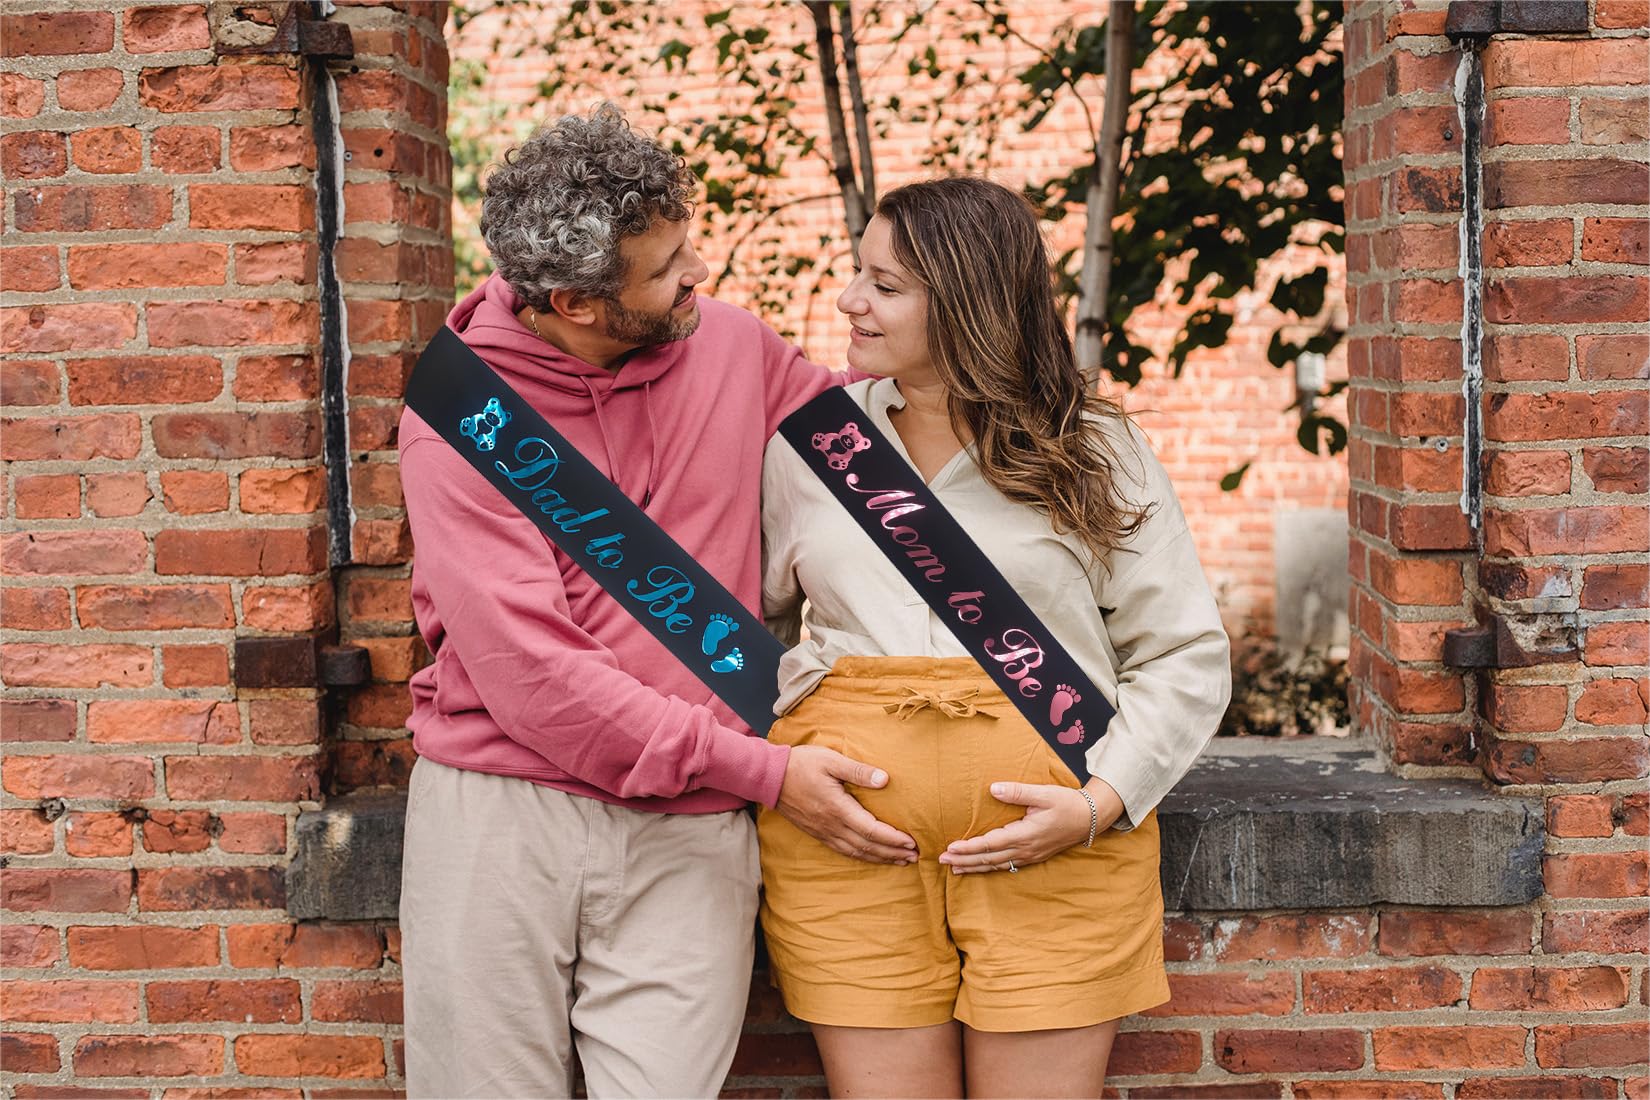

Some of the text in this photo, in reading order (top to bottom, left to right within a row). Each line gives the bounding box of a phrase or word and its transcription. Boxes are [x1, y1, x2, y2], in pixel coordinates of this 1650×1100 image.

[495, 437, 696, 634] Dad to Be
[845, 473, 1045, 698] Mom to Be
